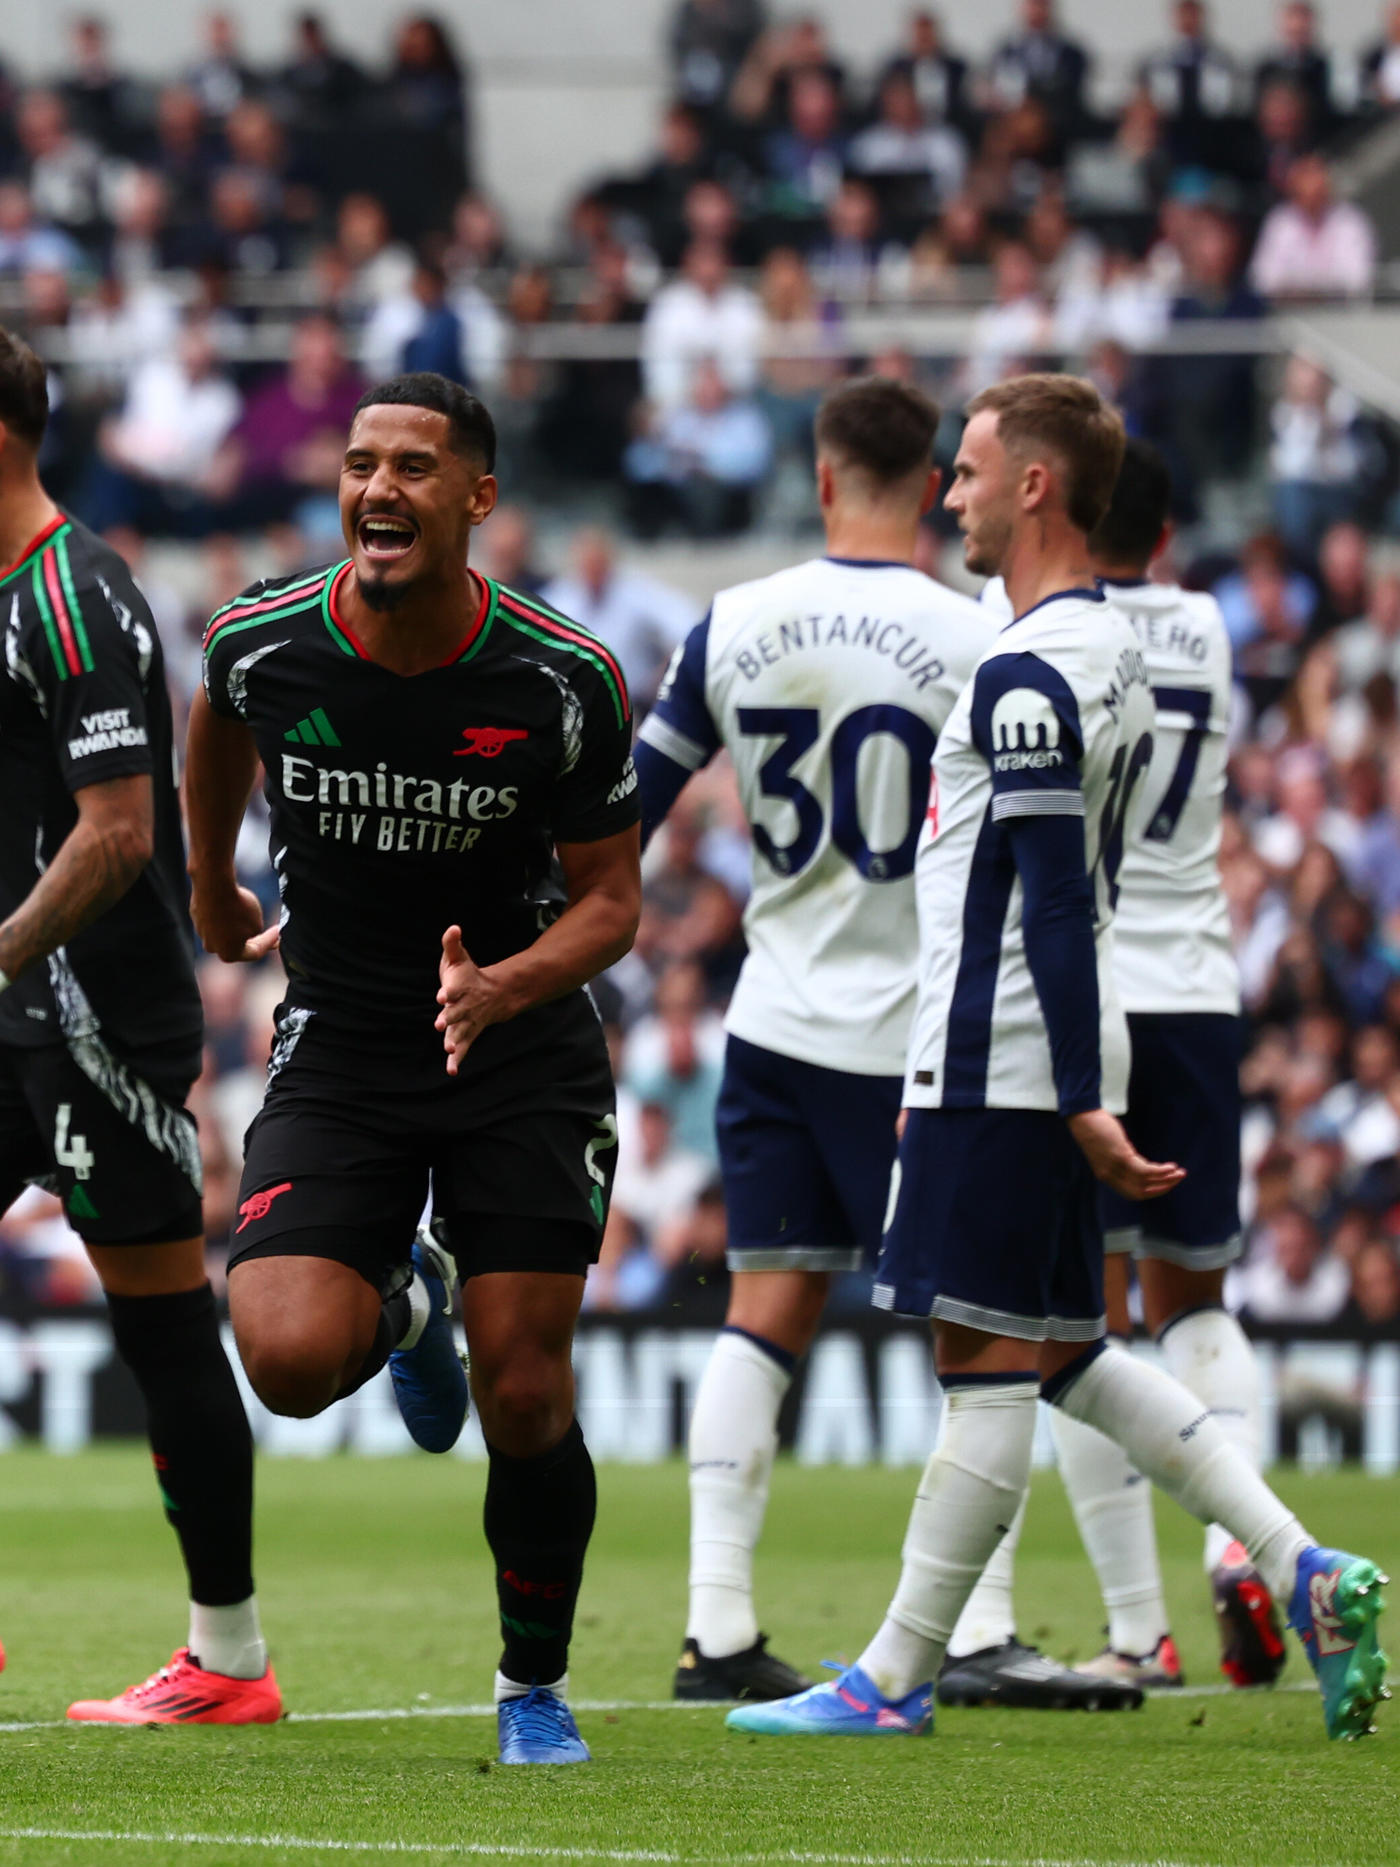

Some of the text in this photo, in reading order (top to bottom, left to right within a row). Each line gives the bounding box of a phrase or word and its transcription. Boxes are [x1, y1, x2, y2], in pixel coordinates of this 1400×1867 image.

[735, 614, 947, 690] BENTANCUR
[80, 707, 130, 735] VISIT
[280, 753, 519, 821] Emirates
[735, 703, 938, 884] 30
[994, 749, 1064, 772] kraken
[377, 815, 482, 853] BETTER
[54, 1103, 95, 1181] 4
[584, 1112, 618, 1188] 2
